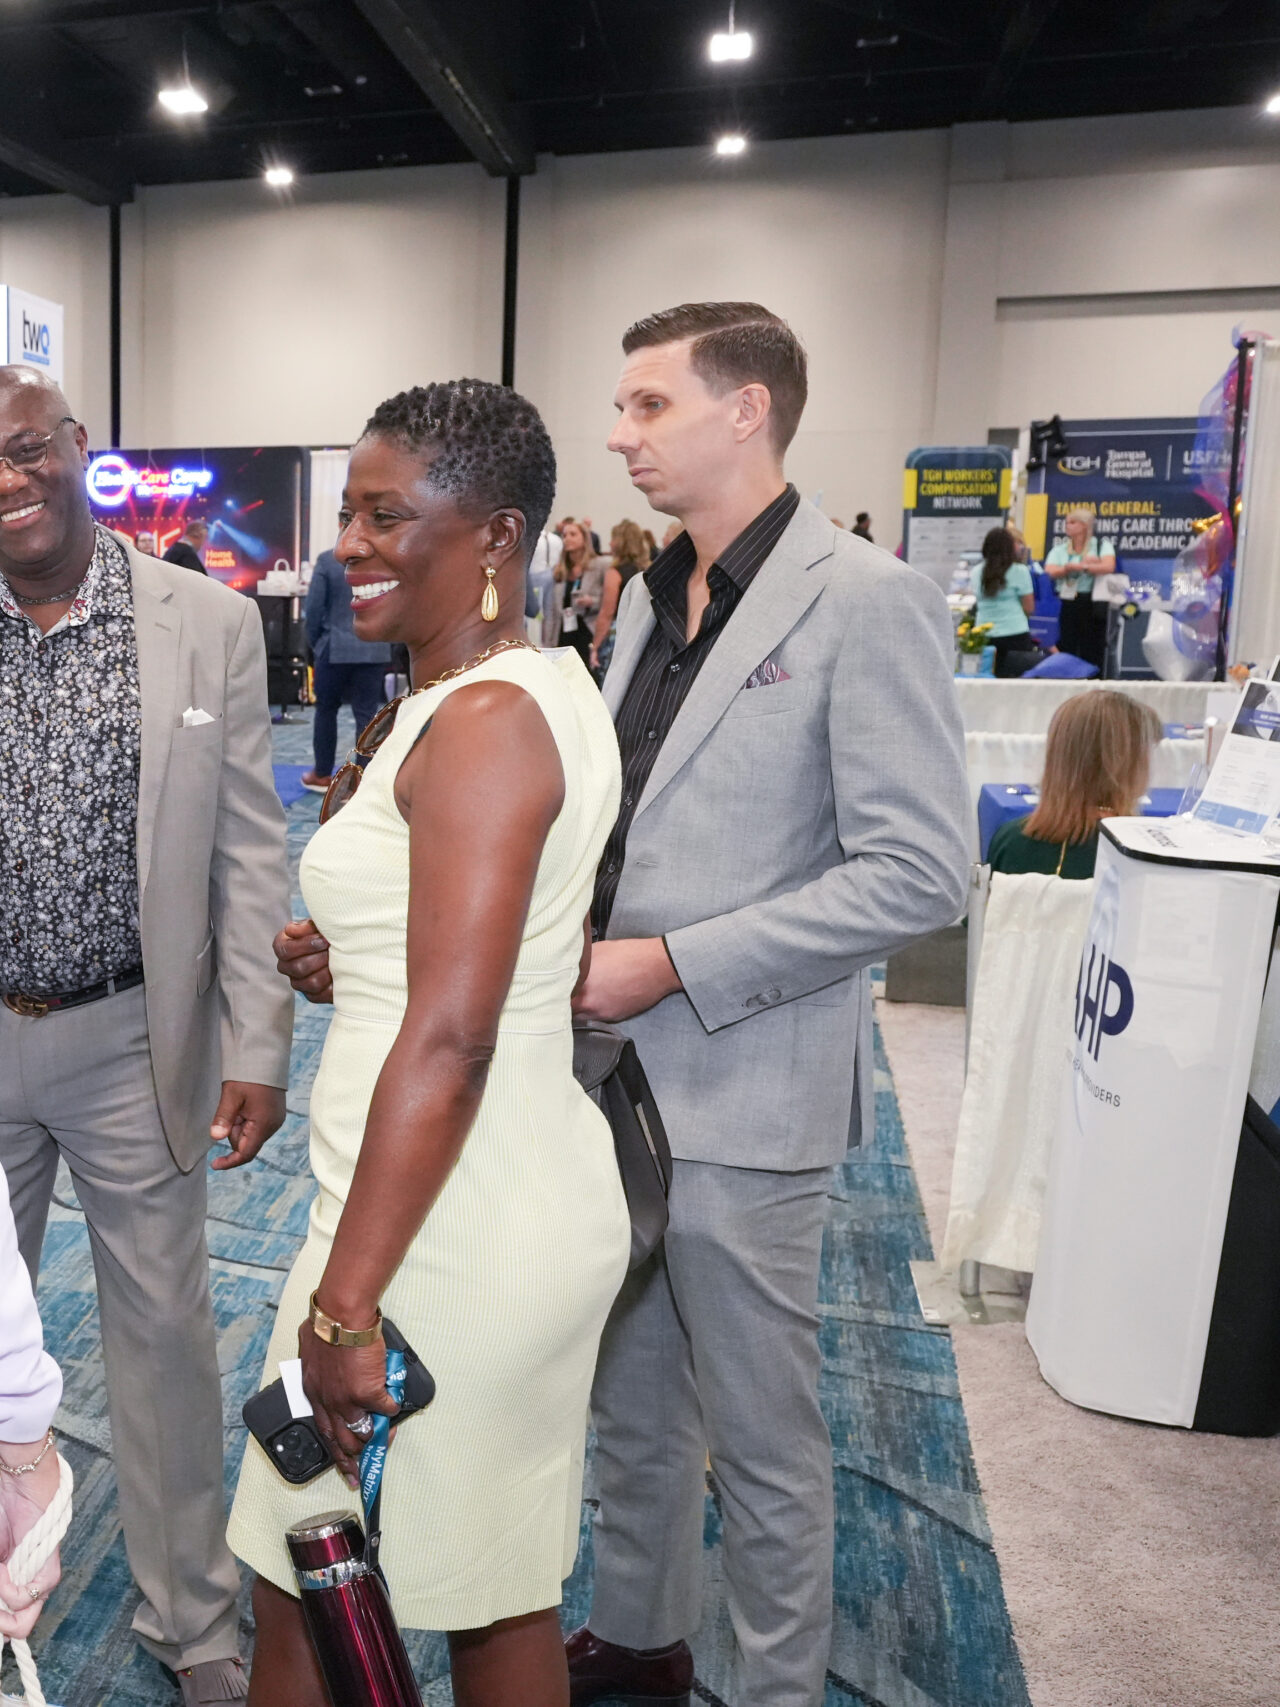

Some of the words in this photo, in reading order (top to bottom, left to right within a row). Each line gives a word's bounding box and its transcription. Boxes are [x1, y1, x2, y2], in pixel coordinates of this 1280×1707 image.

[1065, 455, 1101, 471] TGH
[923, 469, 942, 481] TGH
[920, 483, 998, 496] COMPENSATION
[933, 496, 983, 509] NETWORK
[1099, 501, 1162, 516] GENERAL:
[1122, 517, 1155, 533] CARE
[1120, 533, 1186, 550] ACADEMIC
[205, 549, 233, 558] Home
[205, 558, 236, 568] Health
